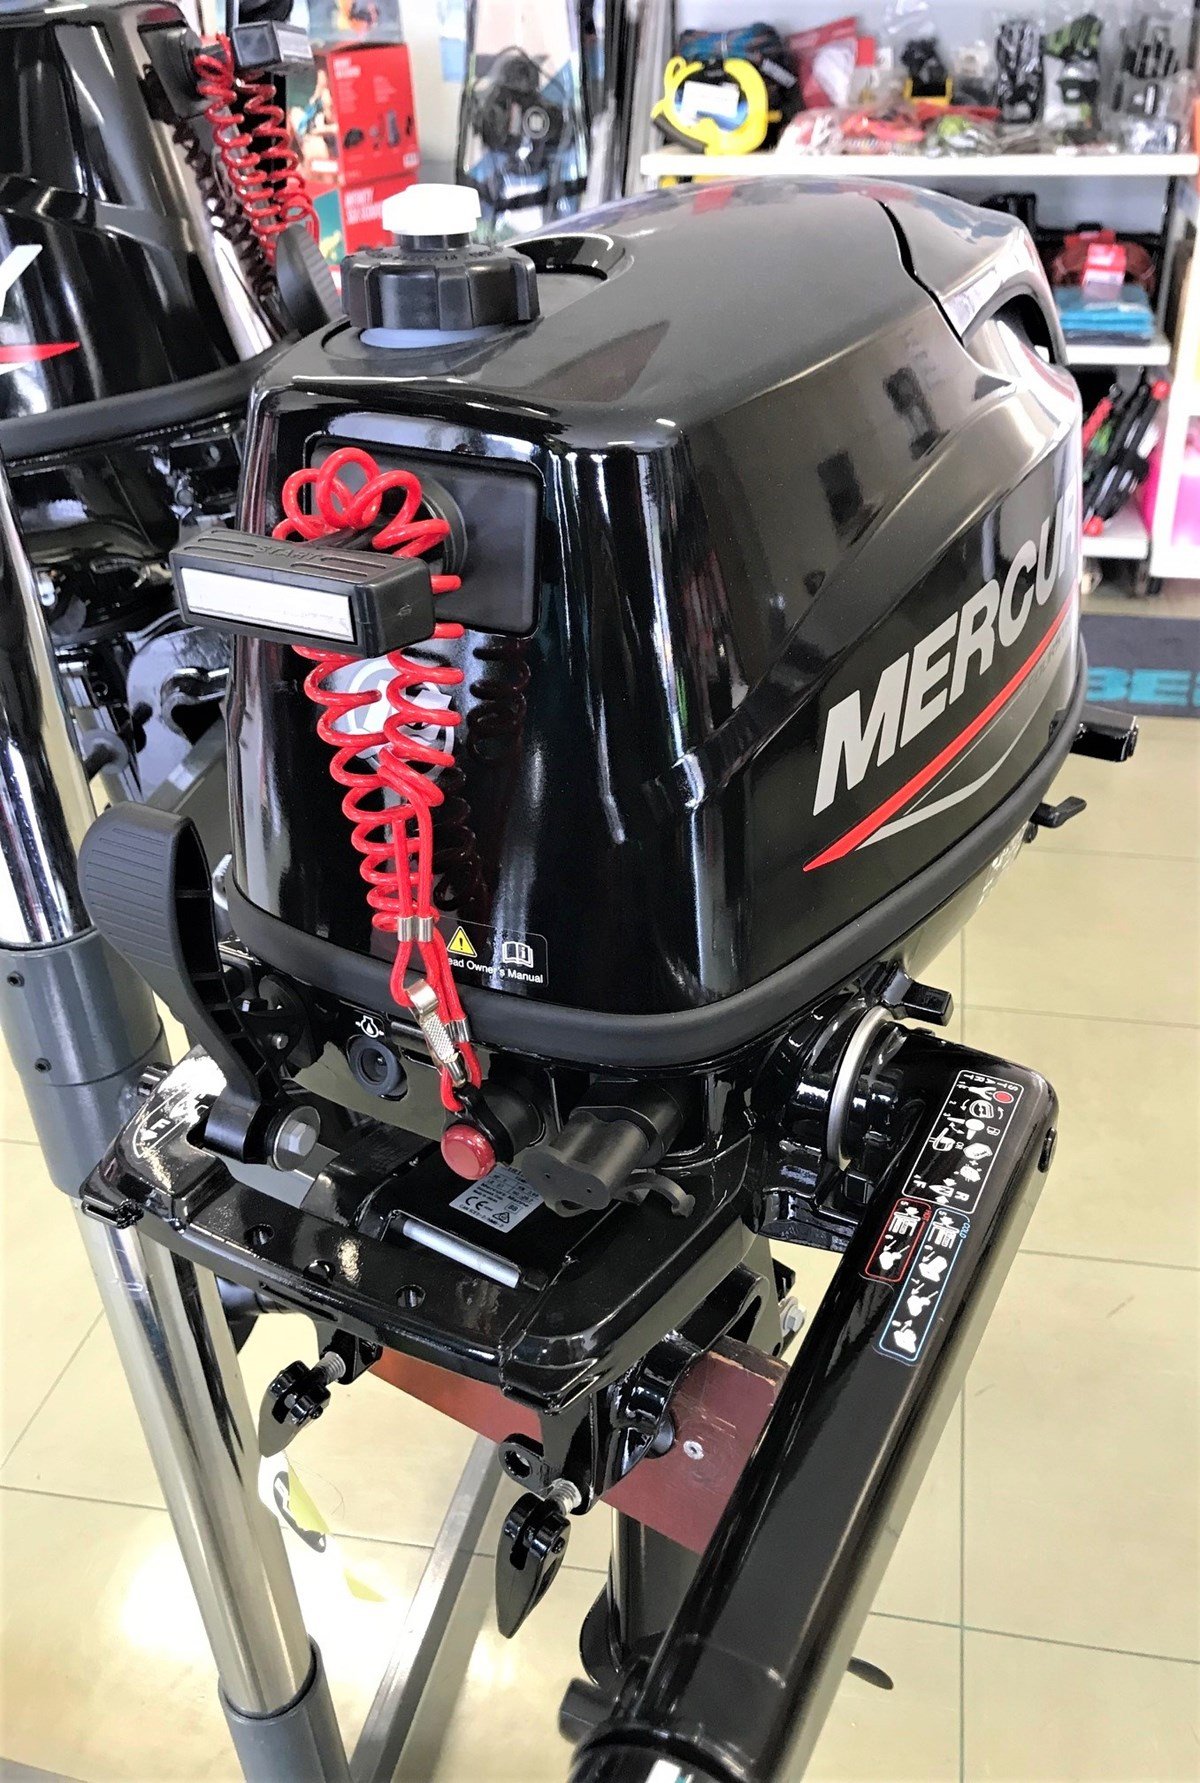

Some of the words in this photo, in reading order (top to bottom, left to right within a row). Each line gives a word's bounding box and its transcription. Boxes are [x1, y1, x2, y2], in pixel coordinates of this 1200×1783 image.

[254, 545, 323, 561] START
[448, 957, 464, 968] ead
[466, 960, 505, 977] Owner's
[507, 968, 544, 984] Manual
